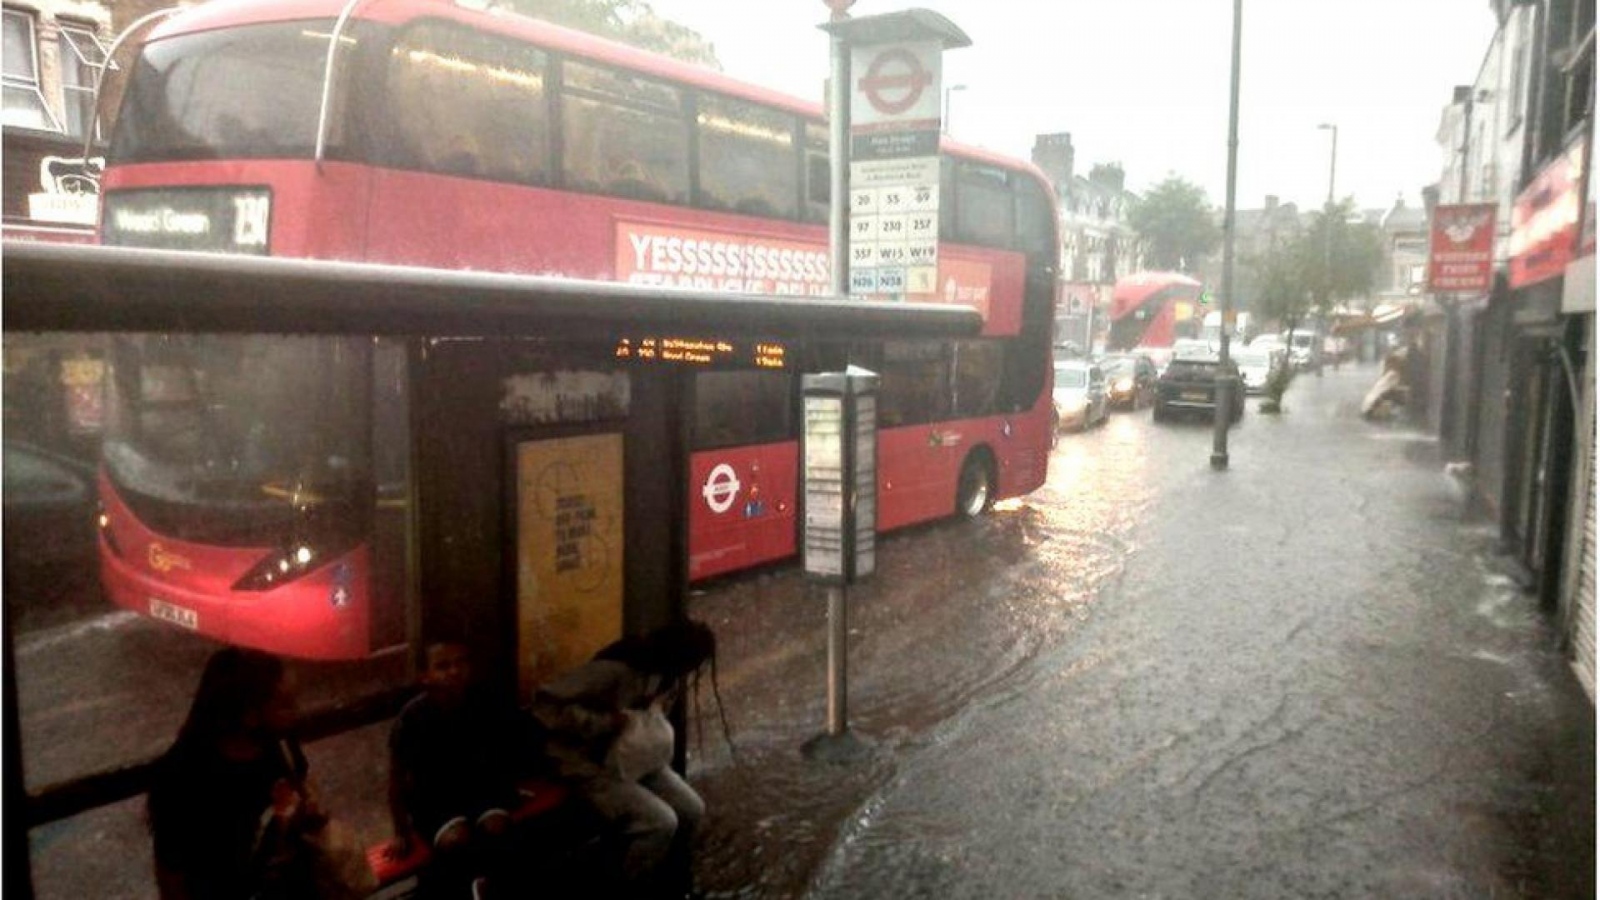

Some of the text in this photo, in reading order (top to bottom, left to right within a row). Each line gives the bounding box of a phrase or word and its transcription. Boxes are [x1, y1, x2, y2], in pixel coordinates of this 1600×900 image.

[857, 194, 870, 205] 20
[886, 194, 900, 205] 55
[857, 222, 869, 232] 97
[883, 220, 901, 232] 230
[880, 248, 904, 259] W15
[909, 246, 935, 257] W19
